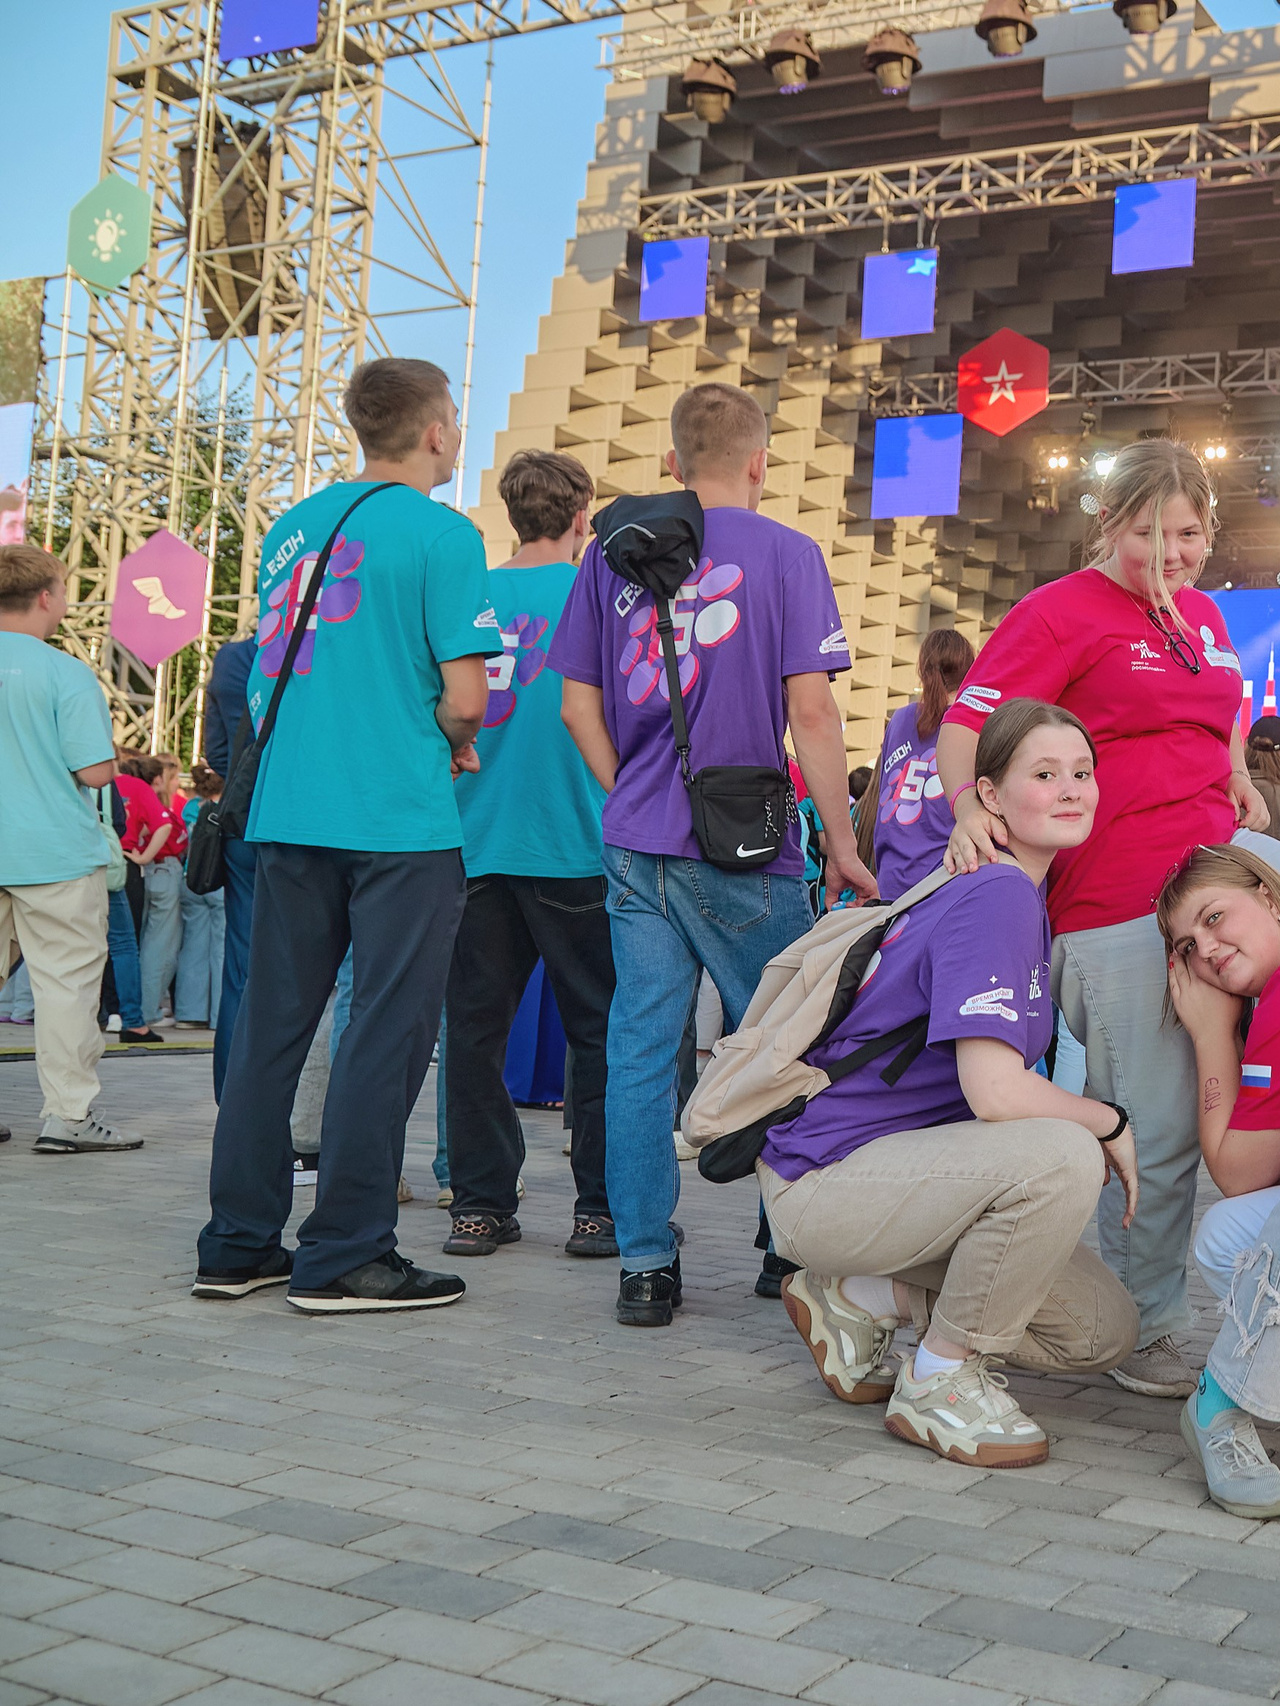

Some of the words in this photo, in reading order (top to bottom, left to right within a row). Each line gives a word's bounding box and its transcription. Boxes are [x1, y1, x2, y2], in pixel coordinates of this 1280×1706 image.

[658, 584, 698, 656] 5
[884, 741, 912, 774] СЕЗОН
[900, 760, 928, 801] 5
[971, 993, 994, 1005] ВРЕМЯ
